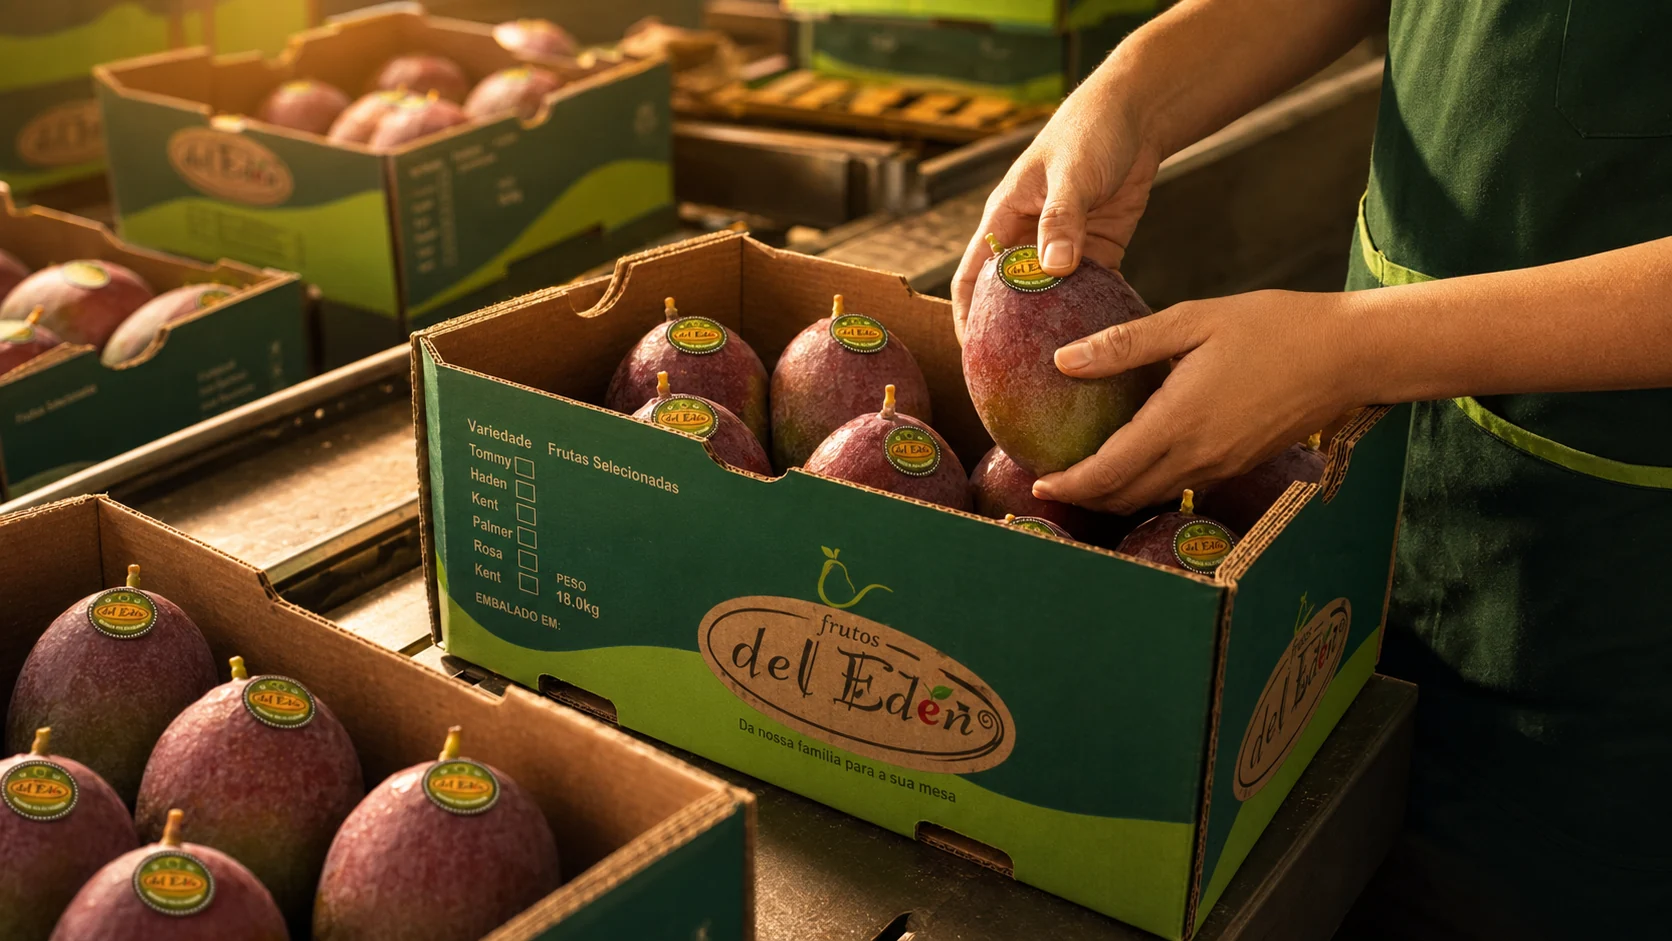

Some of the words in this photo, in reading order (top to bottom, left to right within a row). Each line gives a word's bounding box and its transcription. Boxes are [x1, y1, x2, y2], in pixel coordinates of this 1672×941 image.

[467, 418, 532, 449] Variedade
[468, 443, 512, 470] Tommy
[548, 442, 589, 466] Frutas
[593, 456, 679, 494] Selecionadas
[470, 467, 508, 490] Haden
[471, 491, 499, 511] Kent
[473, 515, 513, 539] Palmer
[474, 539, 503, 560] Rosa
[475, 563, 502, 583] Kent
[556, 573, 587, 592] PESO
[475, 592, 538, 622] EMBALADO
[541, 615, 561, 630] EM:
[556, 590, 600, 618] 18.0kg
[817, 614, 880, 647] frutos
[732, 627, 819, 698] del
[1250, 670, 1291, 769] del
[739, 717, 755, 735] Da
[758, 728, 794, 749] nossa
[798, 740, 841, 766] familia
[845, 759, 875, 778] para
[878, 770, 886, 781] a
[890, 774, 915, 790] sua
[919, 782, 957, 803] mesa
